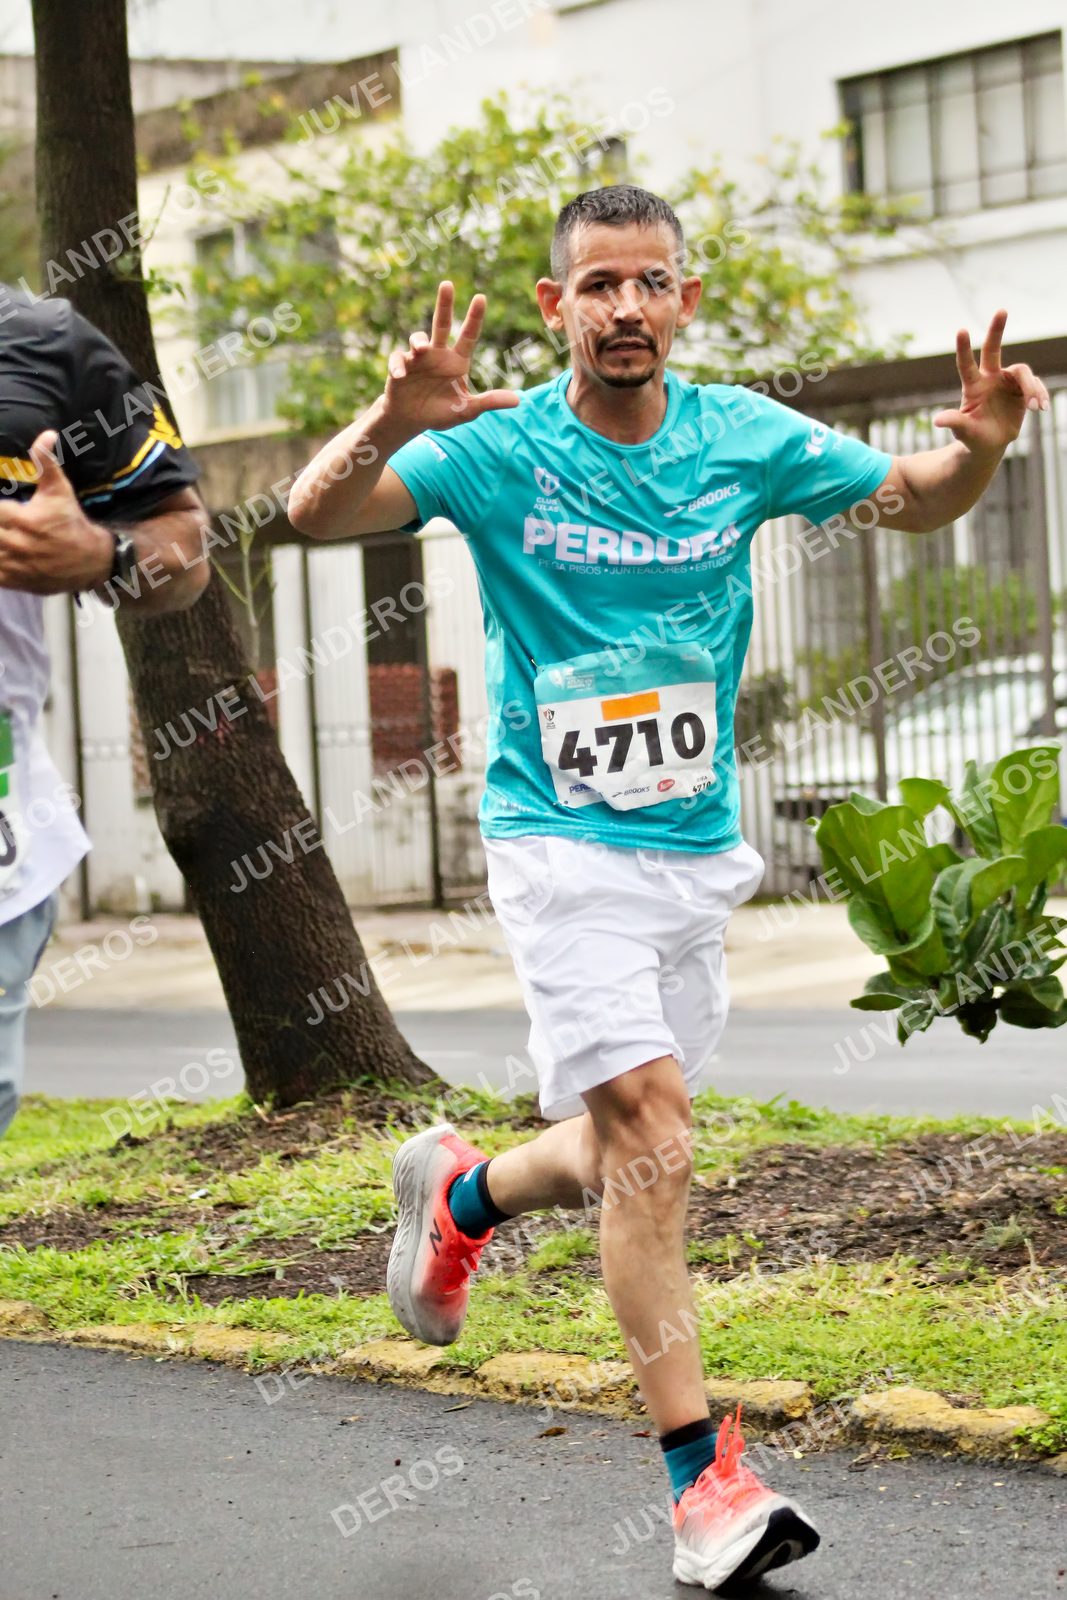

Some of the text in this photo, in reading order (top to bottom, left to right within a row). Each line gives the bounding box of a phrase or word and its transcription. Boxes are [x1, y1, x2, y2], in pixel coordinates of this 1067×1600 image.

[688, 482, 740, 513] BROOKS
[522, 517, 741, 565] PERDURA
[538, 559, 566, 571] PEGA
[569, 563, 602, 575] PISOS
[609, 564, 688, 575] JUNTEADORES
[557, 711, 707, 778] 4710
[623, 786, 651, 796] BROOKS
[692, 780, 712, 793] 4710
